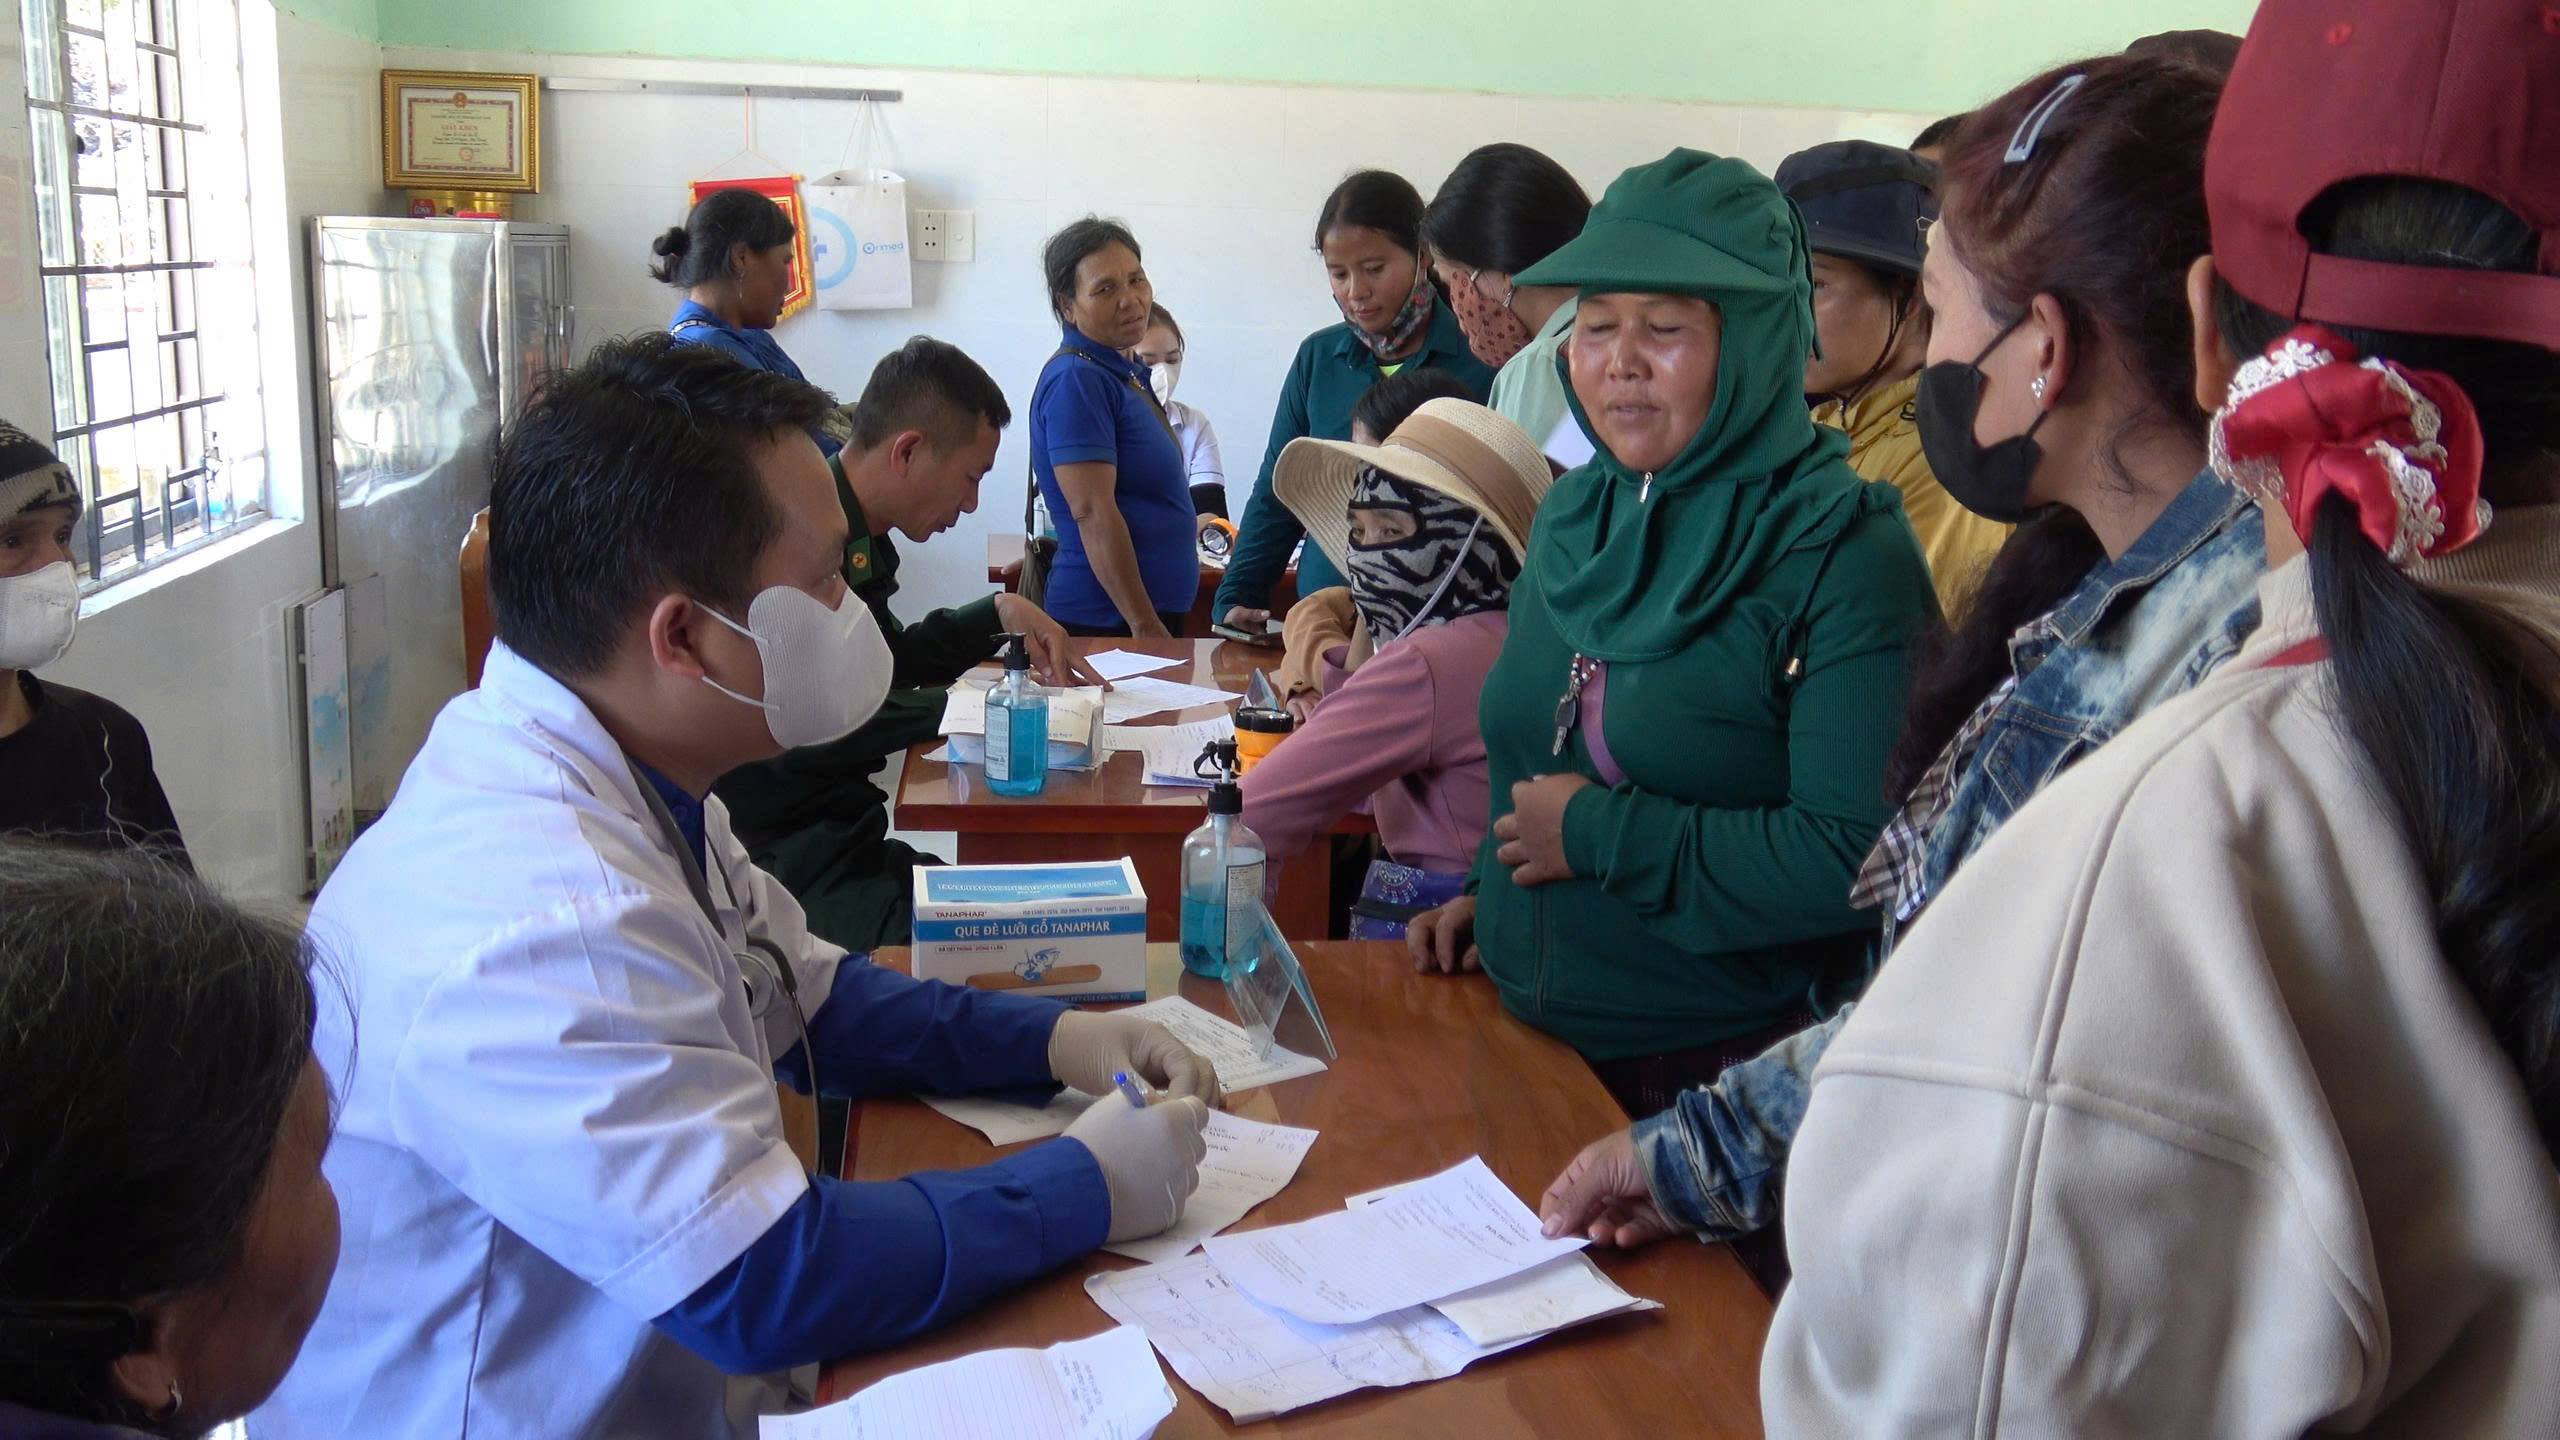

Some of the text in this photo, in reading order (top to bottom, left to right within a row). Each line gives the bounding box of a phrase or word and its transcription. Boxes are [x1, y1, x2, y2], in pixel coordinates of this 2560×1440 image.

[955, 918, 1110, 938] QUE ĐÈ LƯỠI GỖ TANAPHAR
